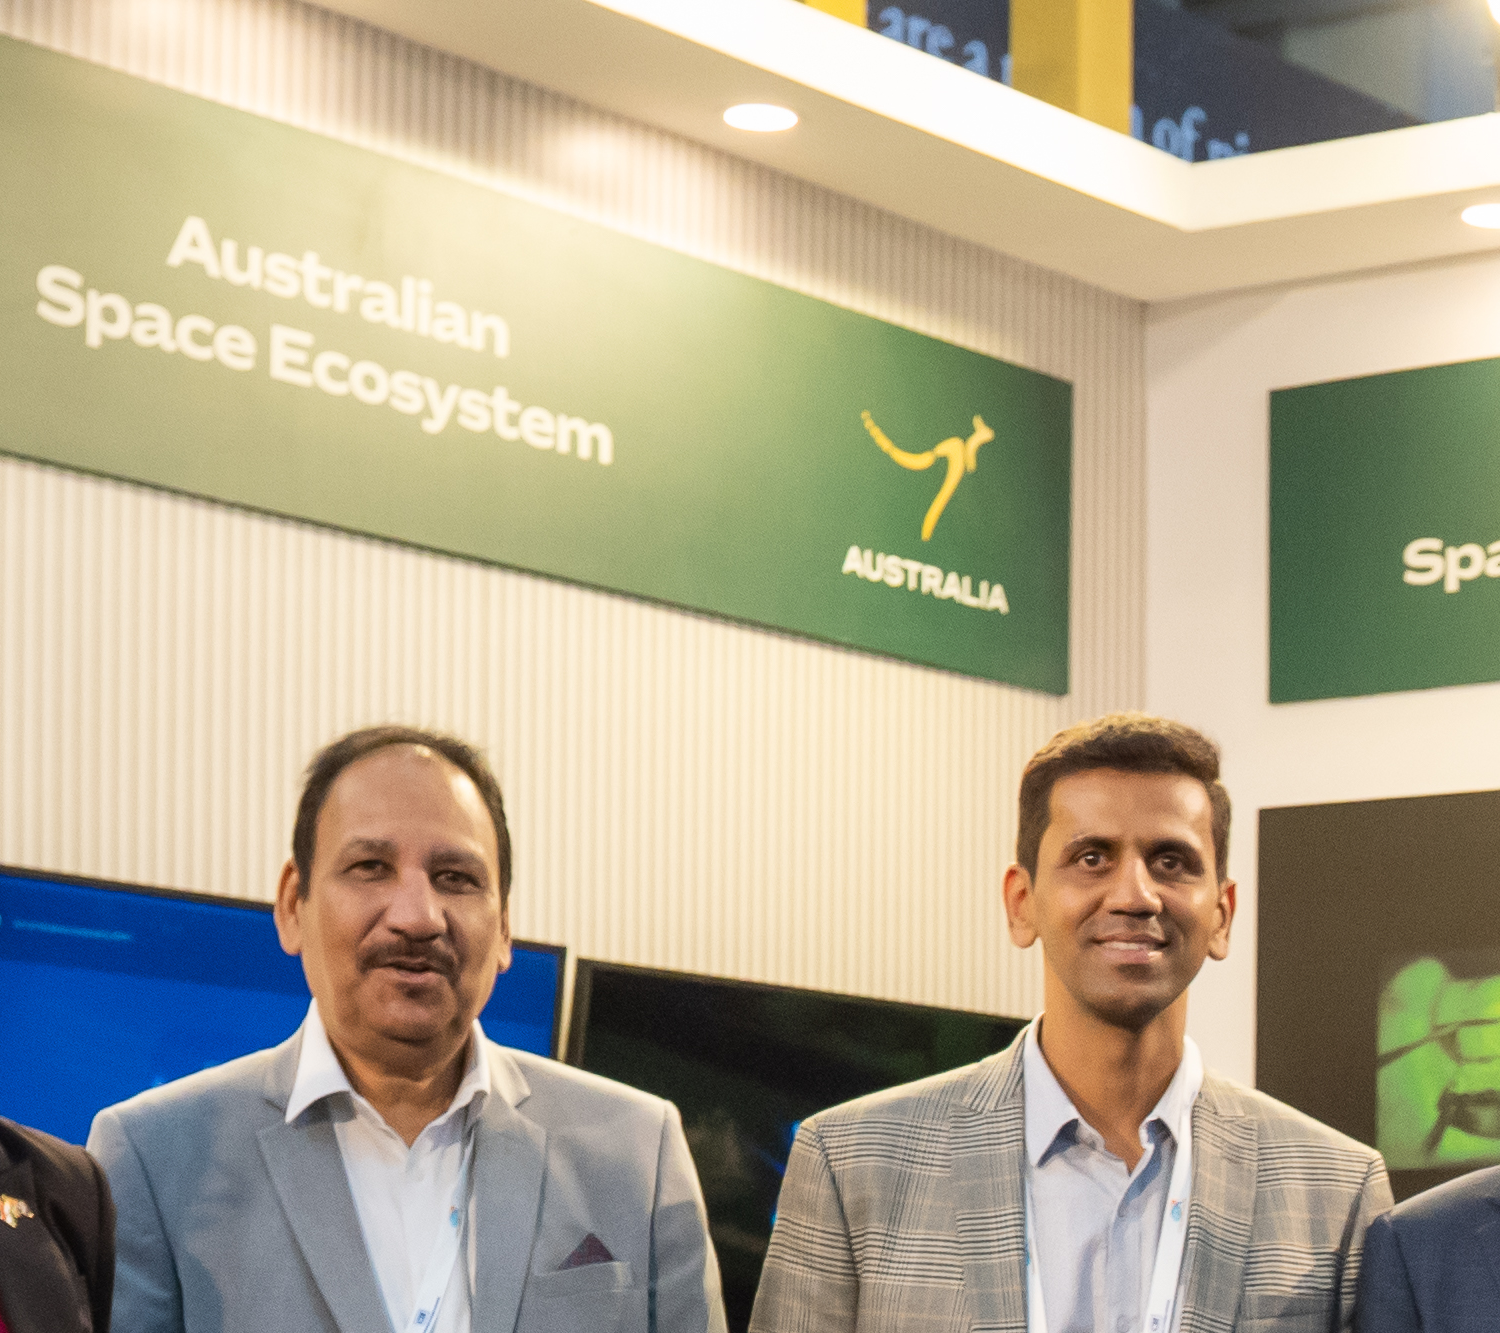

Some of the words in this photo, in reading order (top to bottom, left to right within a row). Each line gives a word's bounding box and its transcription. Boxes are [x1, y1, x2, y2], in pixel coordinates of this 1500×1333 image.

[166, 215, 511, 360] Australian
[35, 265, 257, 372] Space
[267, 325, 614, 466] Ecosystem
[842, 545, 1009, 616] AUSTRALIA
